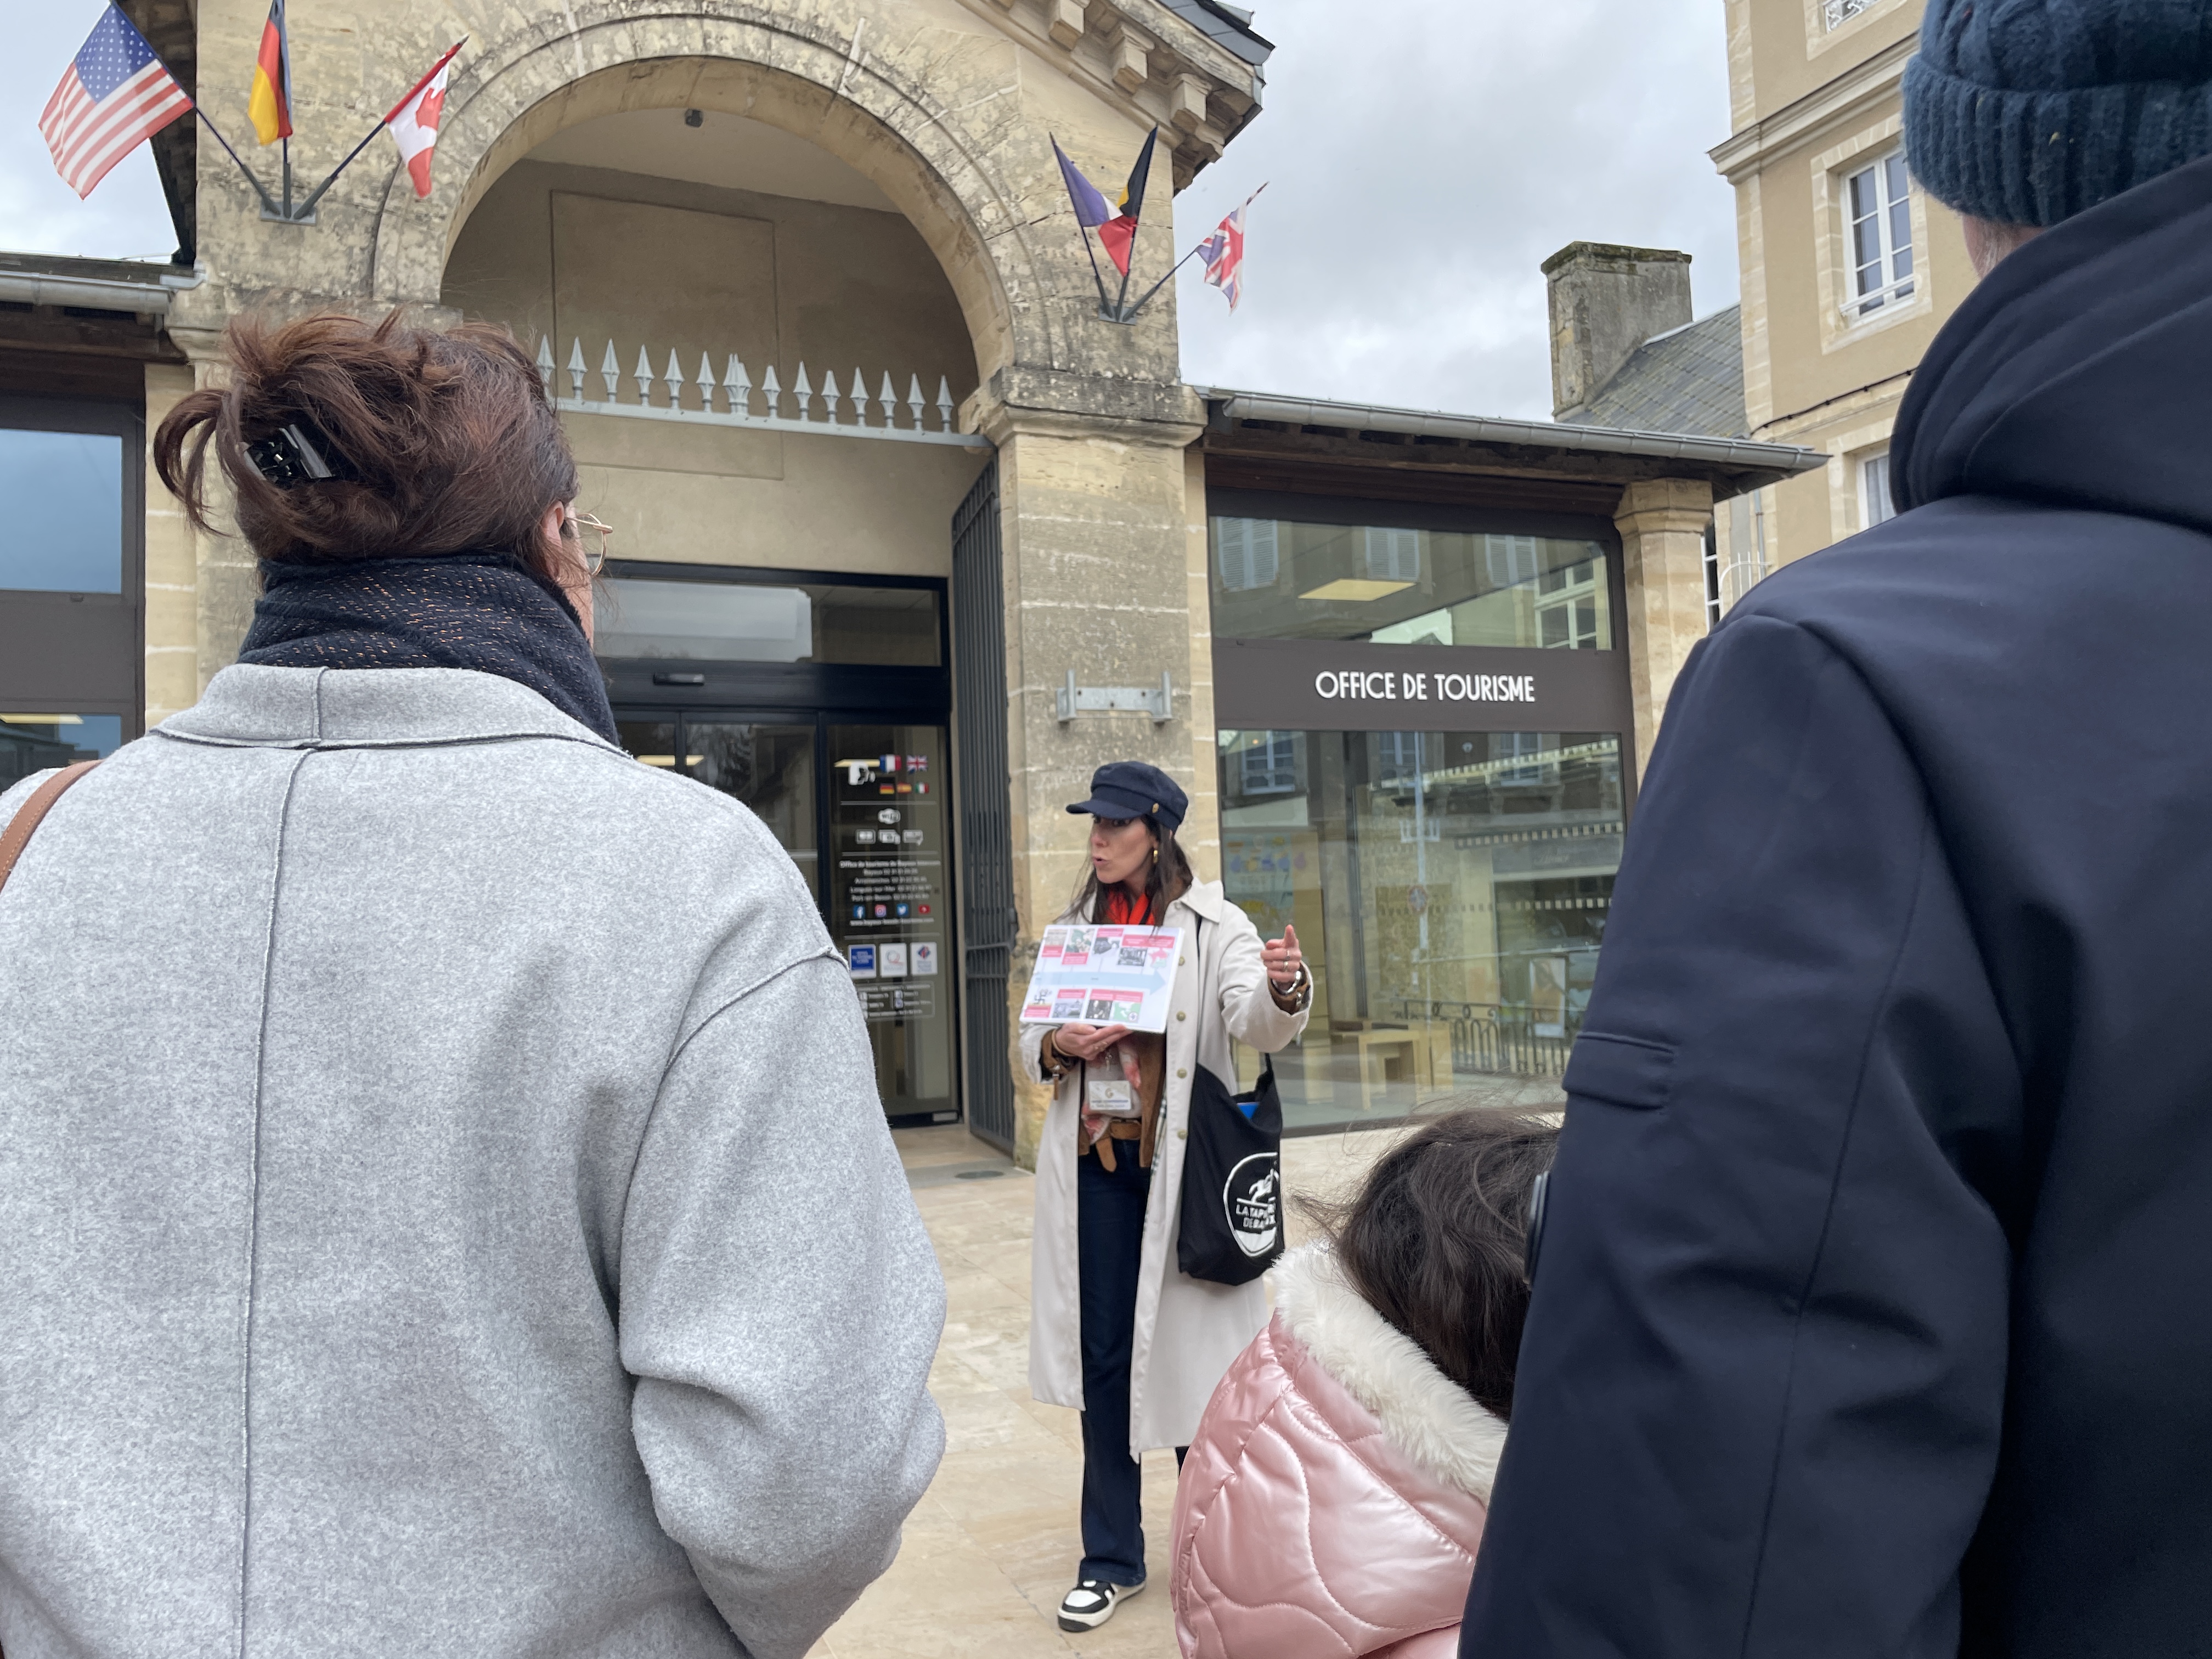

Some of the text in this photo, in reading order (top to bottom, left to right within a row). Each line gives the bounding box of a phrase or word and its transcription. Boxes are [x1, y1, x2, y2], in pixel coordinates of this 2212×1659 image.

[1315, 671, 1535, 702] OFFICE DE TOURISME
[1235, 1204, 1249, 1216] LA
[1243, 1217, 1253, 1228] DE
